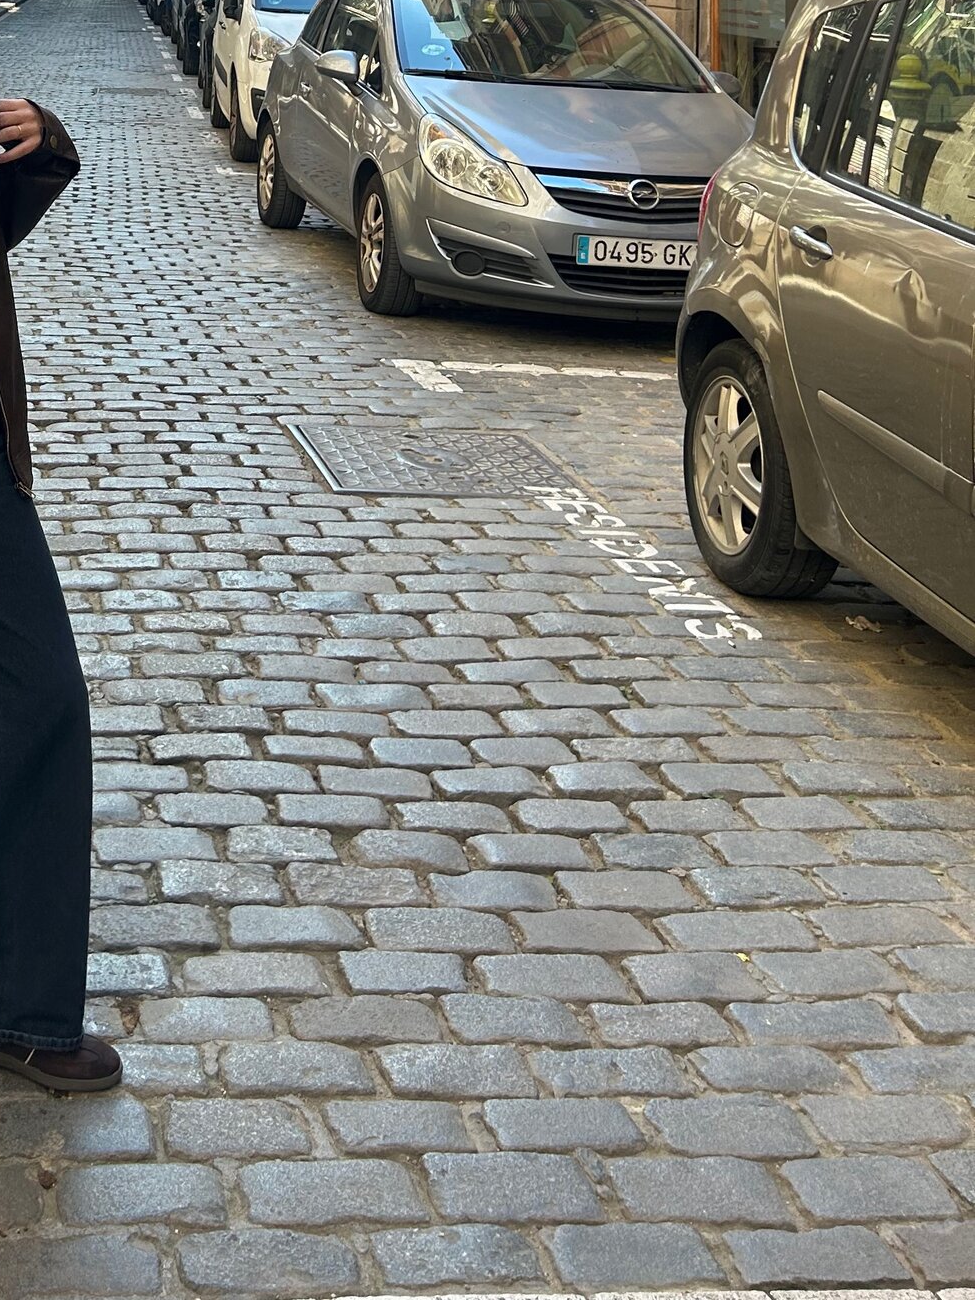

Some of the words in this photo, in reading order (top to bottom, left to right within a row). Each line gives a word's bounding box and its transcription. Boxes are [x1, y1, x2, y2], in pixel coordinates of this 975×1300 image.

[594, 240, 654, 264] 0495
[663, 243, 699, 267] GK
[523, 486, 763, 642] RESIDENTS
